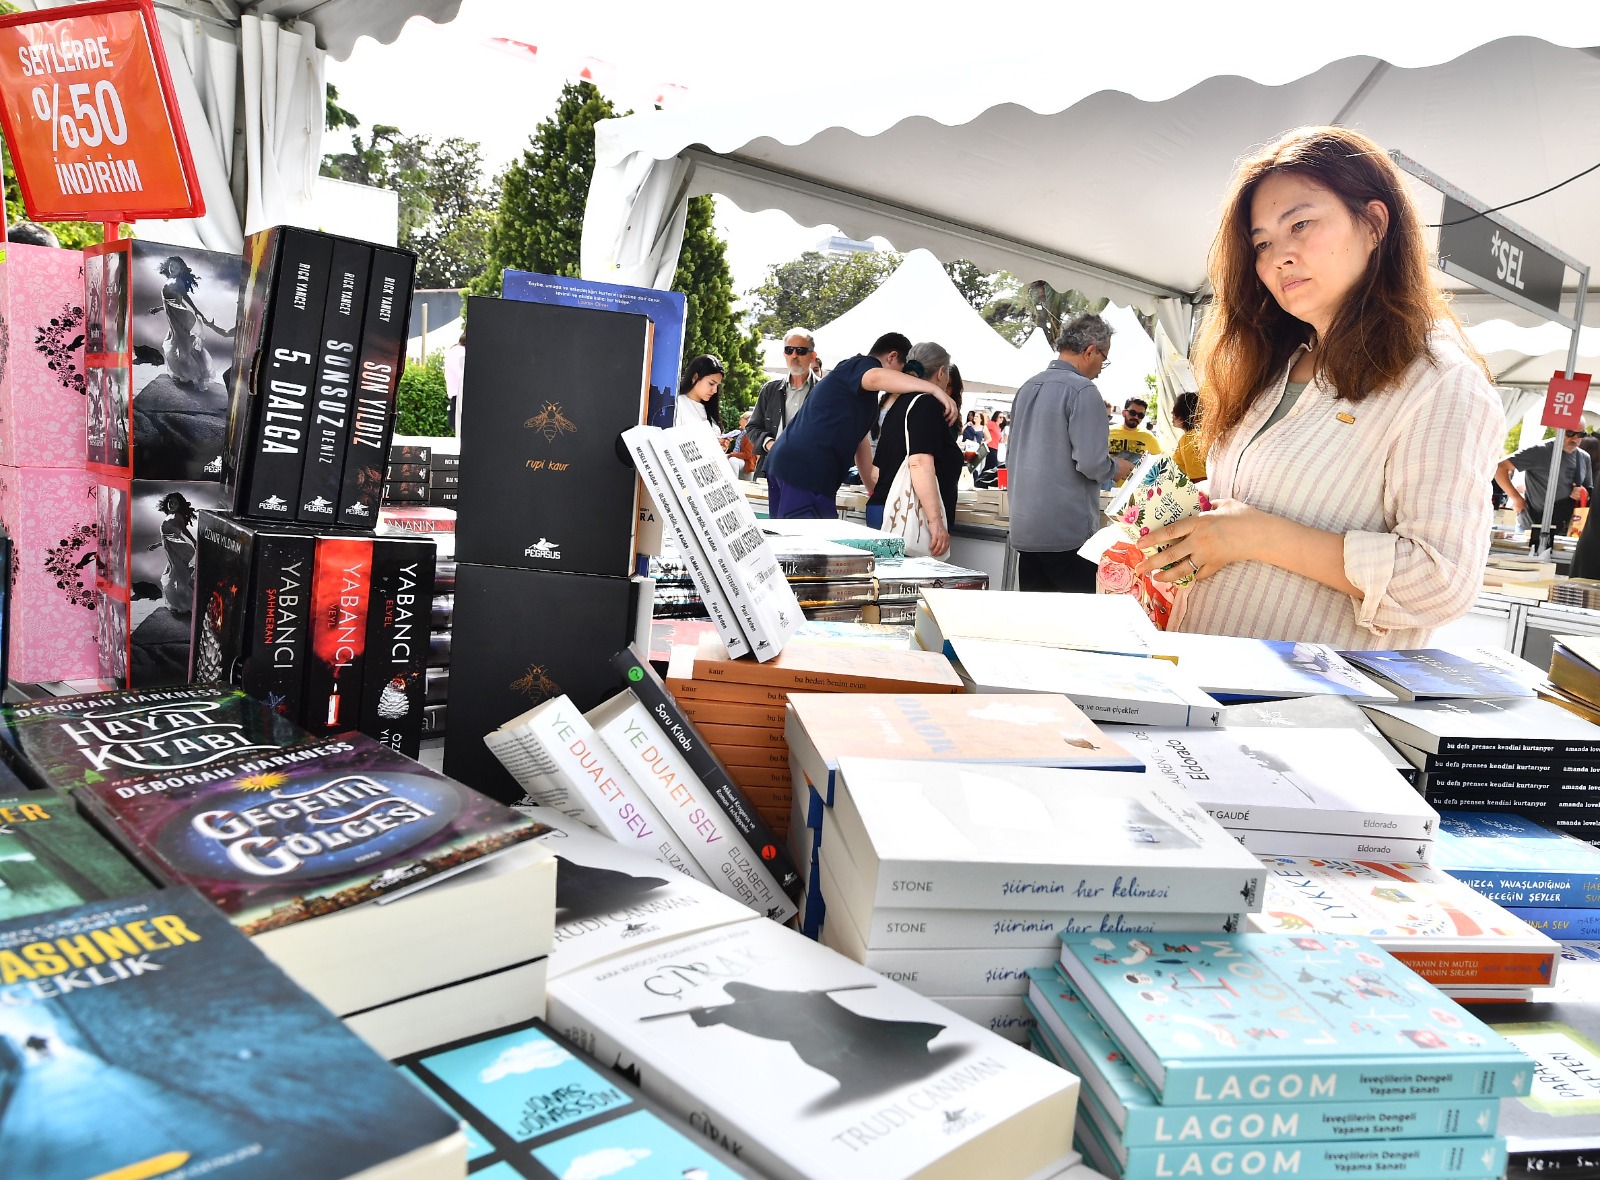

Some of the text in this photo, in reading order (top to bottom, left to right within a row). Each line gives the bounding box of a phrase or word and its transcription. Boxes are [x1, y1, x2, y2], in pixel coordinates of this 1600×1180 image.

[19, 36, 114, 76] SETLERDE
[31, 80, 128, 152] %50
[54, 153, 143, 195] İNDİRİM
[294, 262, 310, 310] RICK YANCEY
[339, 272, 354, 316] RICK YANCEY
[379, 277, 396, 322] RICK YANCEY
[262, 348, 310, 454] 5. DALGA
[316, 340, 354, 428] SONSUZ
[1554, 392, 1574, 404] 50
[352, 361, 392, 449] SON YILDIZ
[1553, 404, 1572, 416] TL
[526, 458, 570, 471] rupi kaur
[258, 502, 288, 512] PEGASUS
[304, 504, 332, 514] PEGASUS
[346, 508, 370, 516] PEGASUS
[524, 548, 560, 560] PEGASUS
[264, 588, 276, 644] ŞAHMERAN
[273, 561, 302, 668] YABANCI
[328, 603, 336, 628] VEYL
[335, 564, 362, 667] YABANCI
[384, 600, 394, 628] ELYEL
[391, 563, 418, 663] YABANCI
[15, 688, 222, 718] DEBORAH HARKNESS
[826, 679, 848, 688] benim
[59, 703, 221, 746] HAYAT
[655, 702, 674, 727] Soru
[671, 723, 693, 752] Kitabı
[77, 731, 254, 771] KİTABI
[116, 742, 354, 799] DEBORAH HARKNESS
[1166, 740, 1210, 780] Eldorado
[550, 712, 654, 840] YE DUA ET SEV
[622, 718, 722, 844] YE DUA ET SEV
[192, 777, 390, 840] GECENİN
[1216, 809, 1398, 830] GAUDÉ Eldorado
[227, 800, 436, 875] GÖLGESİ
[1357, 844, 1391, 854] Eldorado
[658, 842, 695, 879] ELIZAB
[728, 846, 773, 902] ELIZABETH
[721, 862, 758, 905] GILBERT
[892, 880, 933, 892] STONE
[1072, 879, 1104, 898] her
[1112, 876, 1170, 898] kelimesi
[1529, 892, 1560, 902] ŞEYLER
[554, 917, 607, 942] RUDI
[608, 896, 700, 922] CANAVAN
[886, 922, 926, 934] STONE
[1063, 917, 1092, 933] her
[1099, 914, 1156, 933] kelimesi
[1552, 921, 1570, 930] SEV
[0, 914, 202, 984] ASHNER
[985, 966, 1030, 983] şiirim
[990, 1014, 1037, 1030] şiirim
[831, 1056, 1007, 1152] TRUDI CANAVAN
[1194, 1074, 1453, 1100] LAGOM İsveçlilerin Dengeli
[1369, 1086, 1440, 1096] Yaşama Sanatı
[1155, 1112, 1416, 1141] LAGOM İsveçlilerin Dengeli
[1332, 1125, 1403, 1135] Yaşama Sanatı
[1156, 1150, 1420, 1177] LAGOM İsveçlilerin Dengeli
[1334, 1162, 1406, 1172] Yaşama Sanatı
